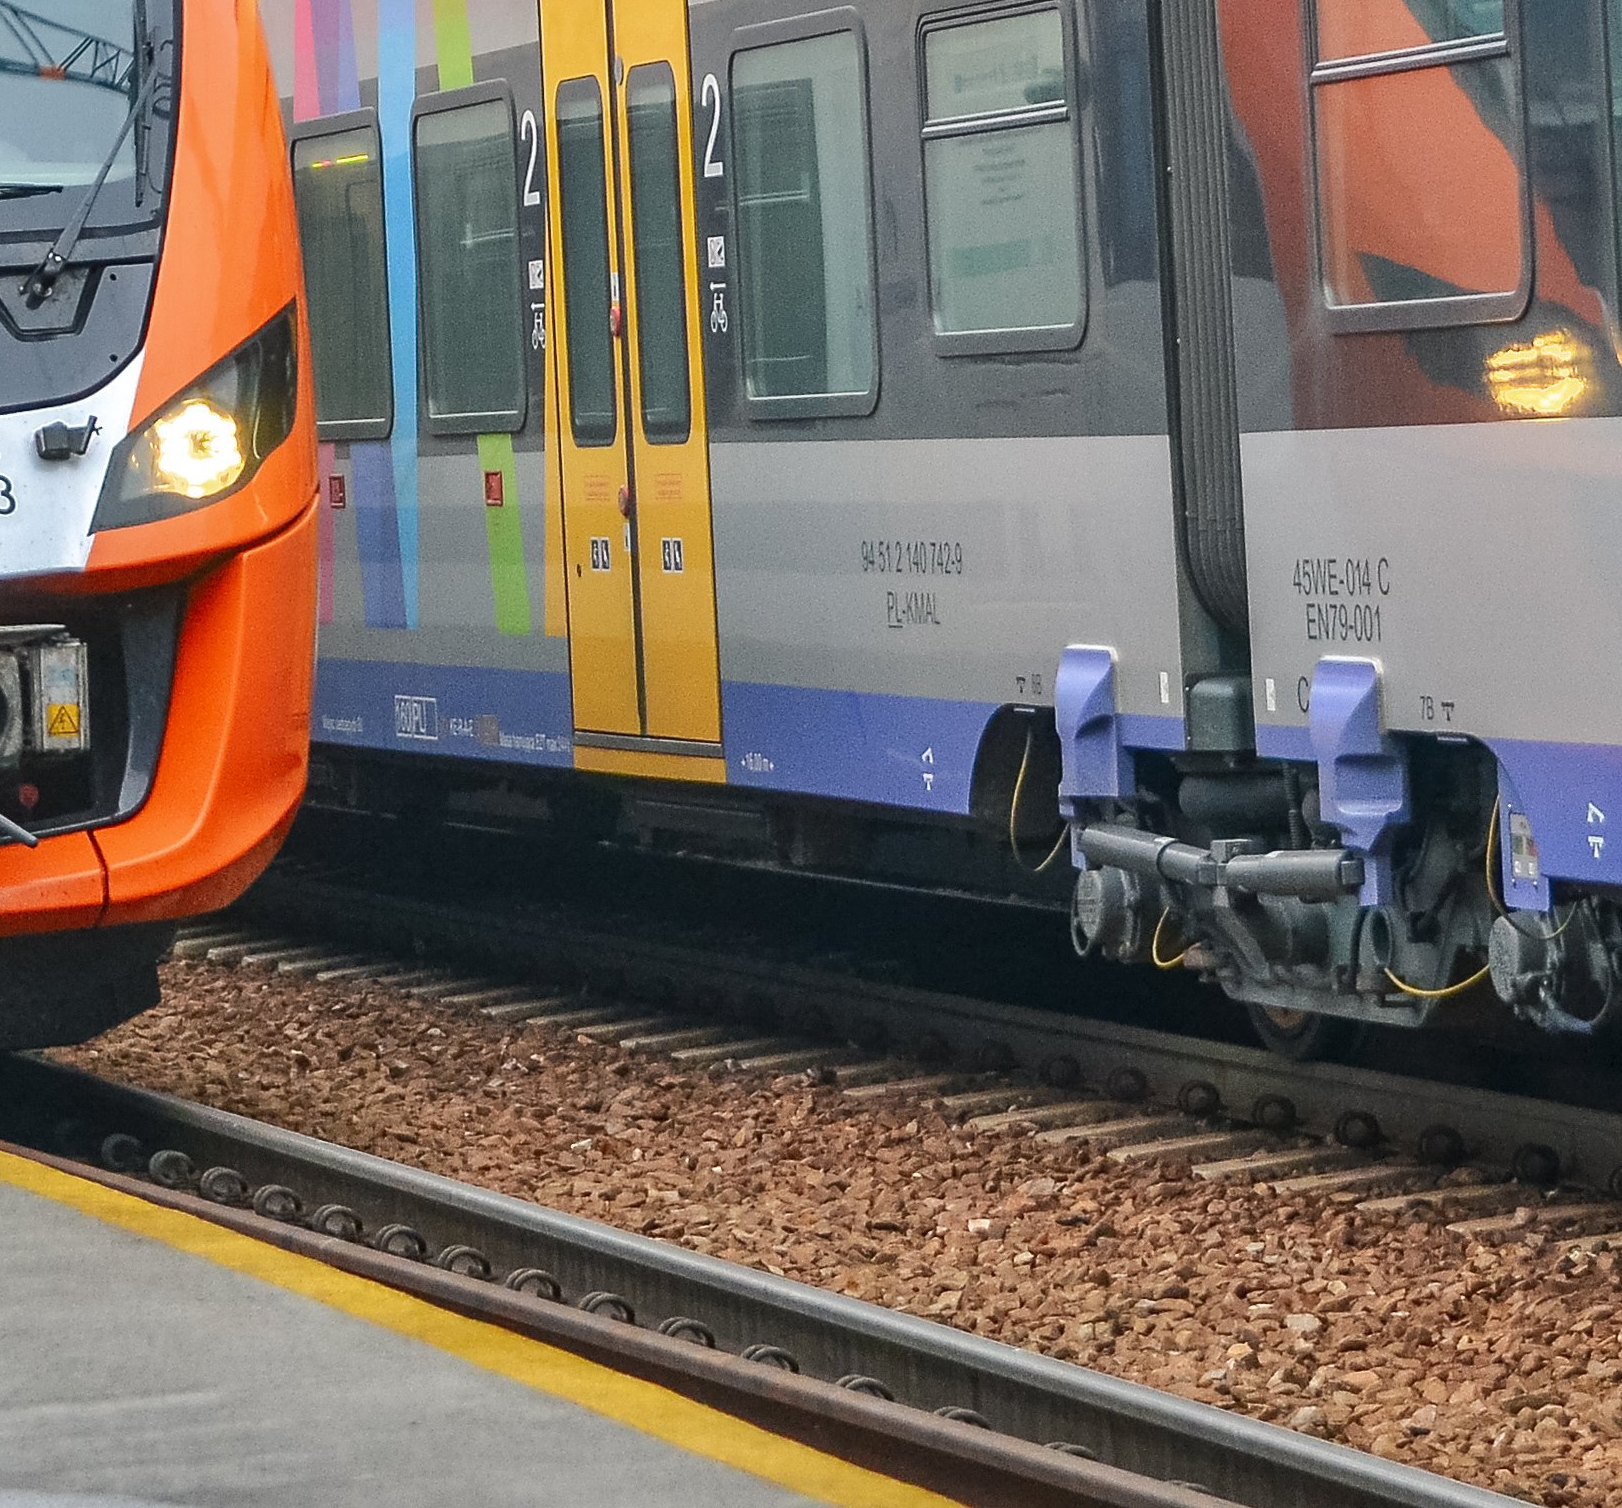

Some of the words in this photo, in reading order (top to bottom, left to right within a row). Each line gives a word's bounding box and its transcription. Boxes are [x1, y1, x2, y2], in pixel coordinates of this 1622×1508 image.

[701, 73, 724, 177] 2
[521, 110, 540, 206] 2
[861, 541, 875, 572] 94
[879, 541, 891, 573] 51
[895, 541, 903, 573] 2
[906, 541, 927, 574] 140
[930, 542, 963, 575] 742-9
[1293, 558, 1371, 596] 45WE-014
[1378, 557, 1390, 596] C
[886, 591, 941, 628] PL-KMAL
[1306, 603, 1382, 642] EN79-001
[1420, 695, 1434, 720] 7B
